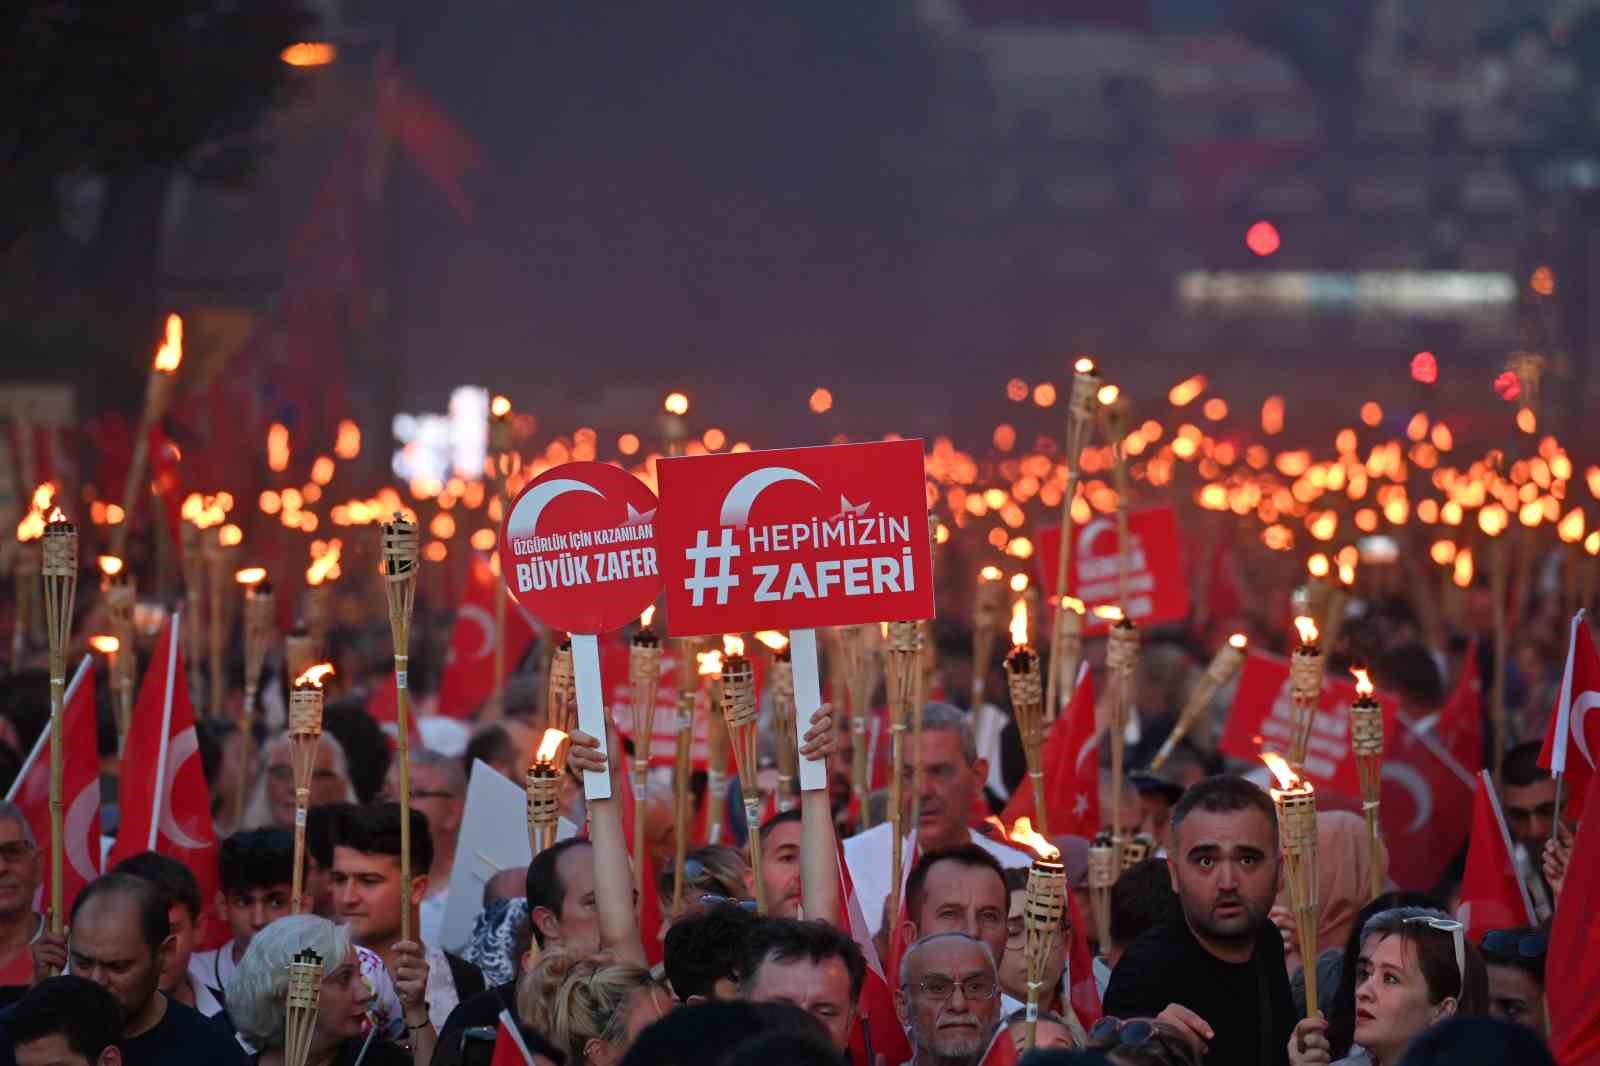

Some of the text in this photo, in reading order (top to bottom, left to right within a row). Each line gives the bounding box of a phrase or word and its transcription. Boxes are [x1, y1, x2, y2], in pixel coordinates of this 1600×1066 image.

[513, 523, 654, 556] ÖZGÜRLÜK İÇİN KAZANILAN
[748, 512, 911, 552] HEPİMİZİN
[516, 546, 659, 593] BÜYÜK ZAFER
[751, 546, 915, 602] ZAFERİ
